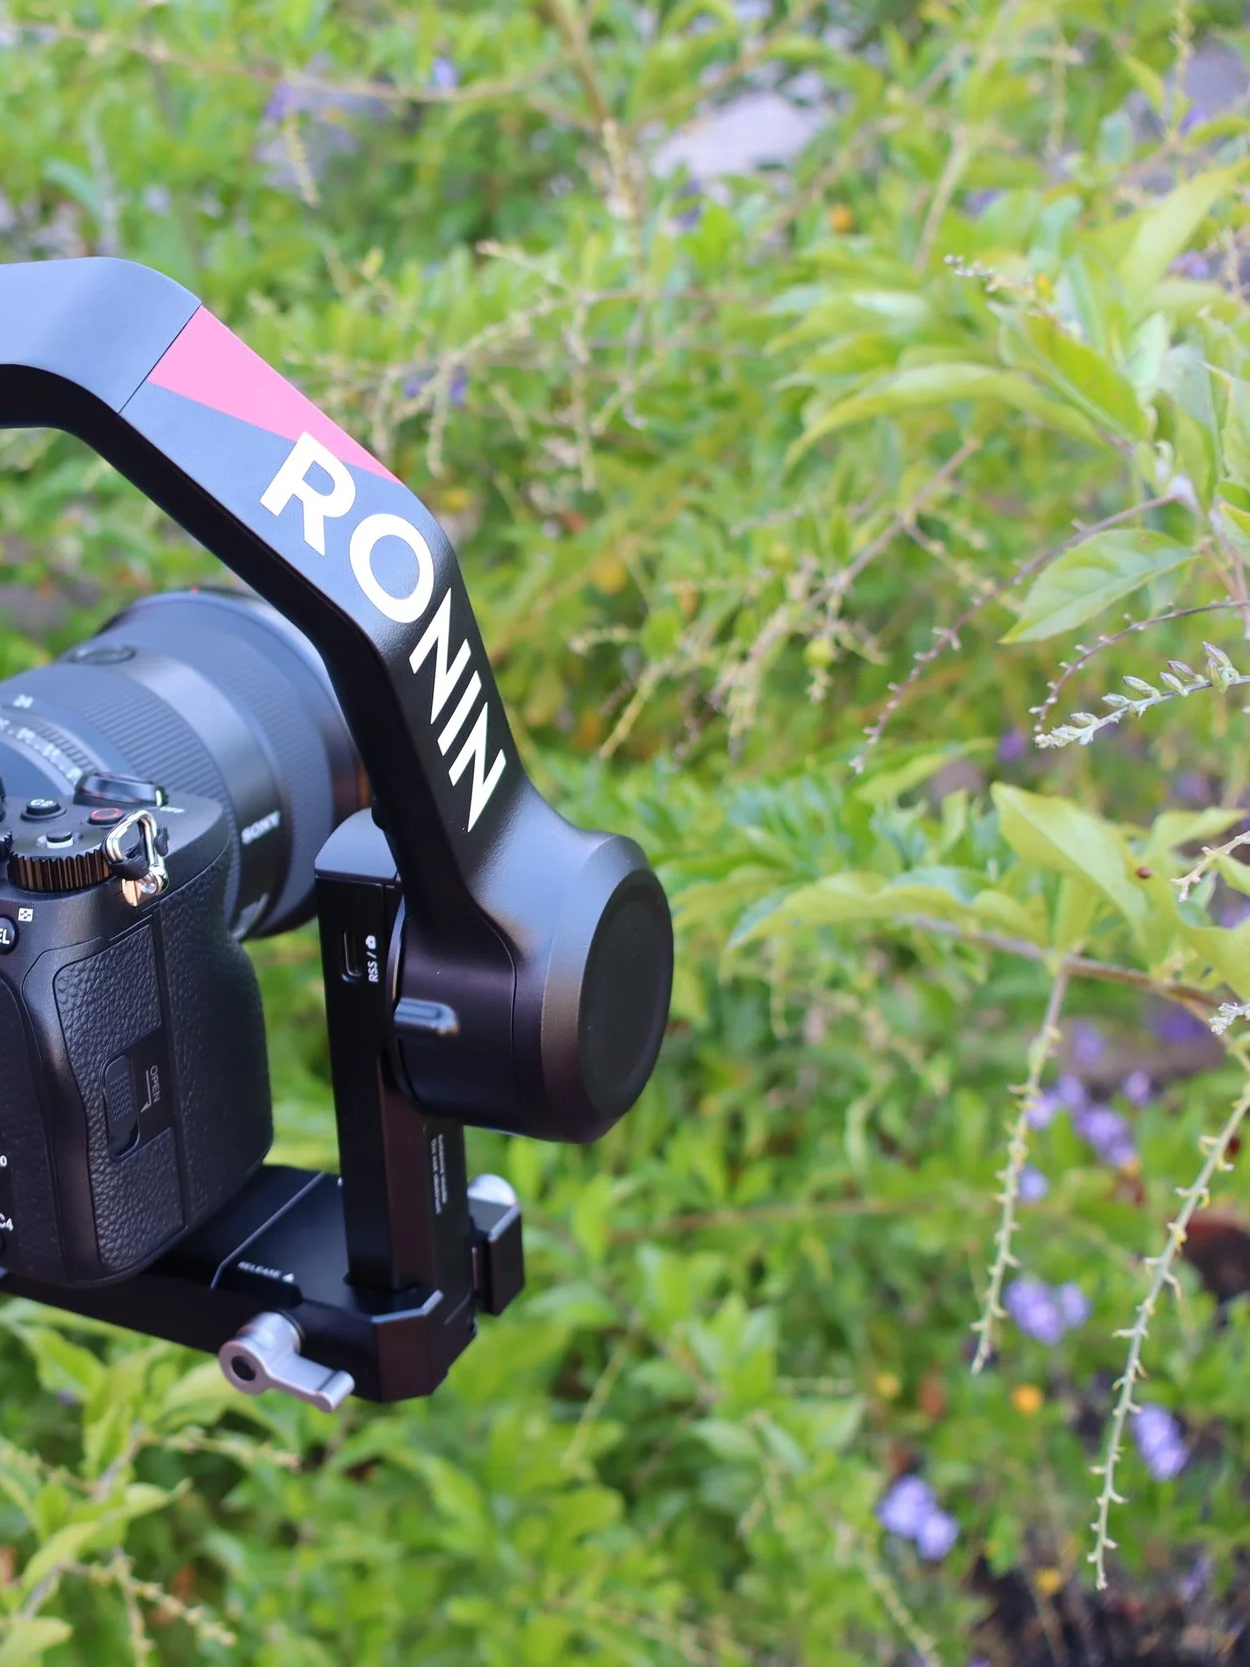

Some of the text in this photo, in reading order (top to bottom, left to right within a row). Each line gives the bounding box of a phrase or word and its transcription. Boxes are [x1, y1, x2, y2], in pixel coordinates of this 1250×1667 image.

[259, 430, 507, 833] RONIN
[241, 810, 281, 845] SONY
[367, 960, 379, 983] RSS
[150, 1065, 161, 1103] OPEN
[237, 1261, 282, 1279] RELEASE
